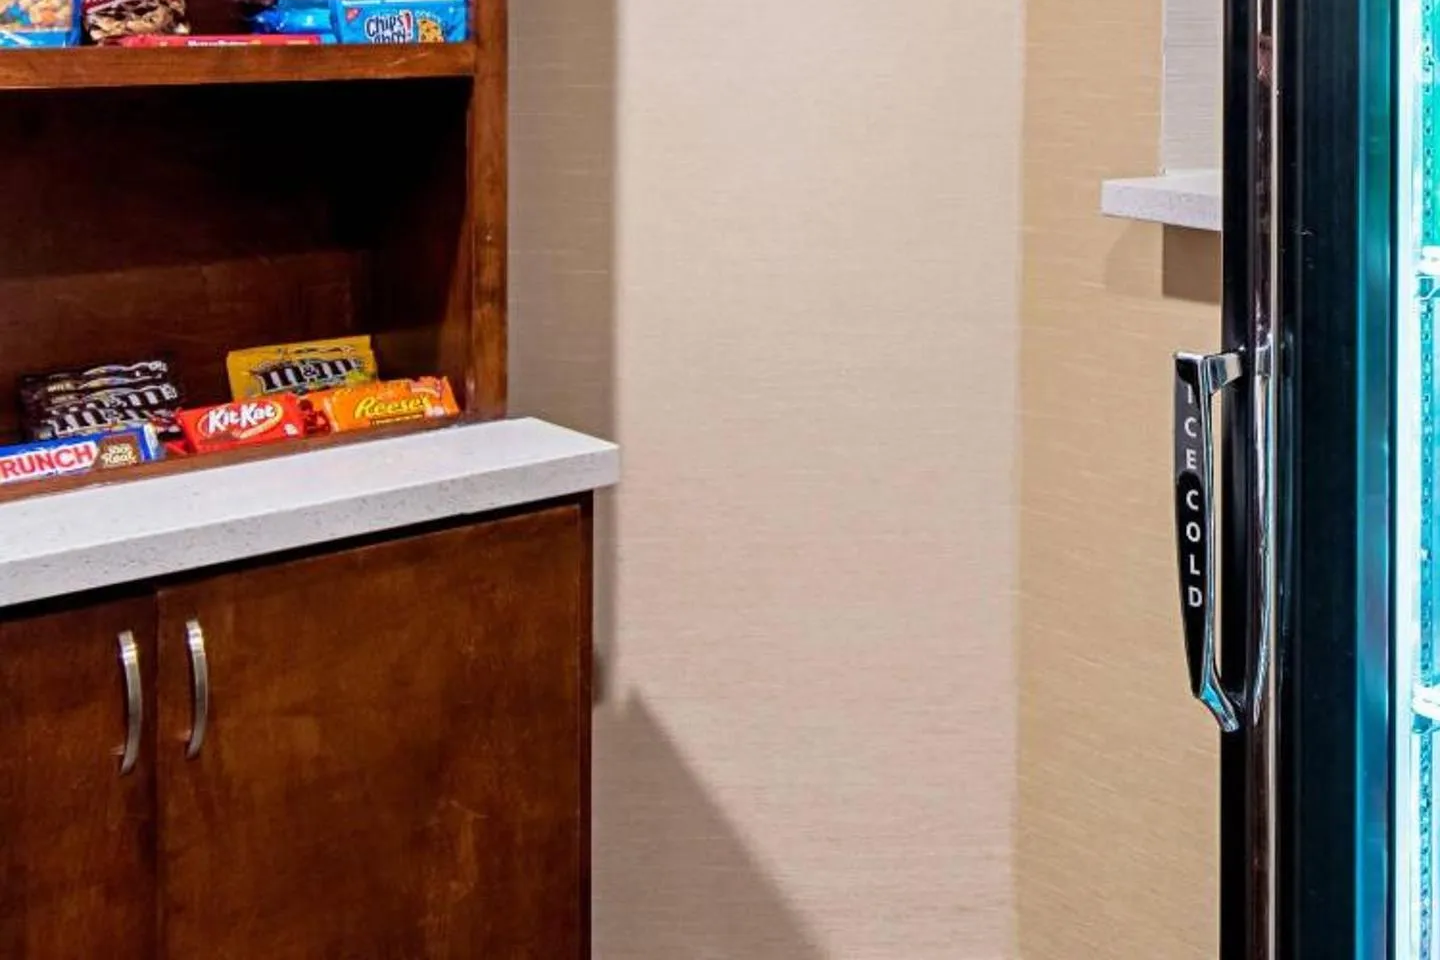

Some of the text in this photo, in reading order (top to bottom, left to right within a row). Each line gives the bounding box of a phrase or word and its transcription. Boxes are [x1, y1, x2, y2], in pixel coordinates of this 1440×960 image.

[354, 393, 431, 419] Reese's
[1, 444, 93, 478] RUNCH
[1184, 383, 1203, 608] ICE COLD
